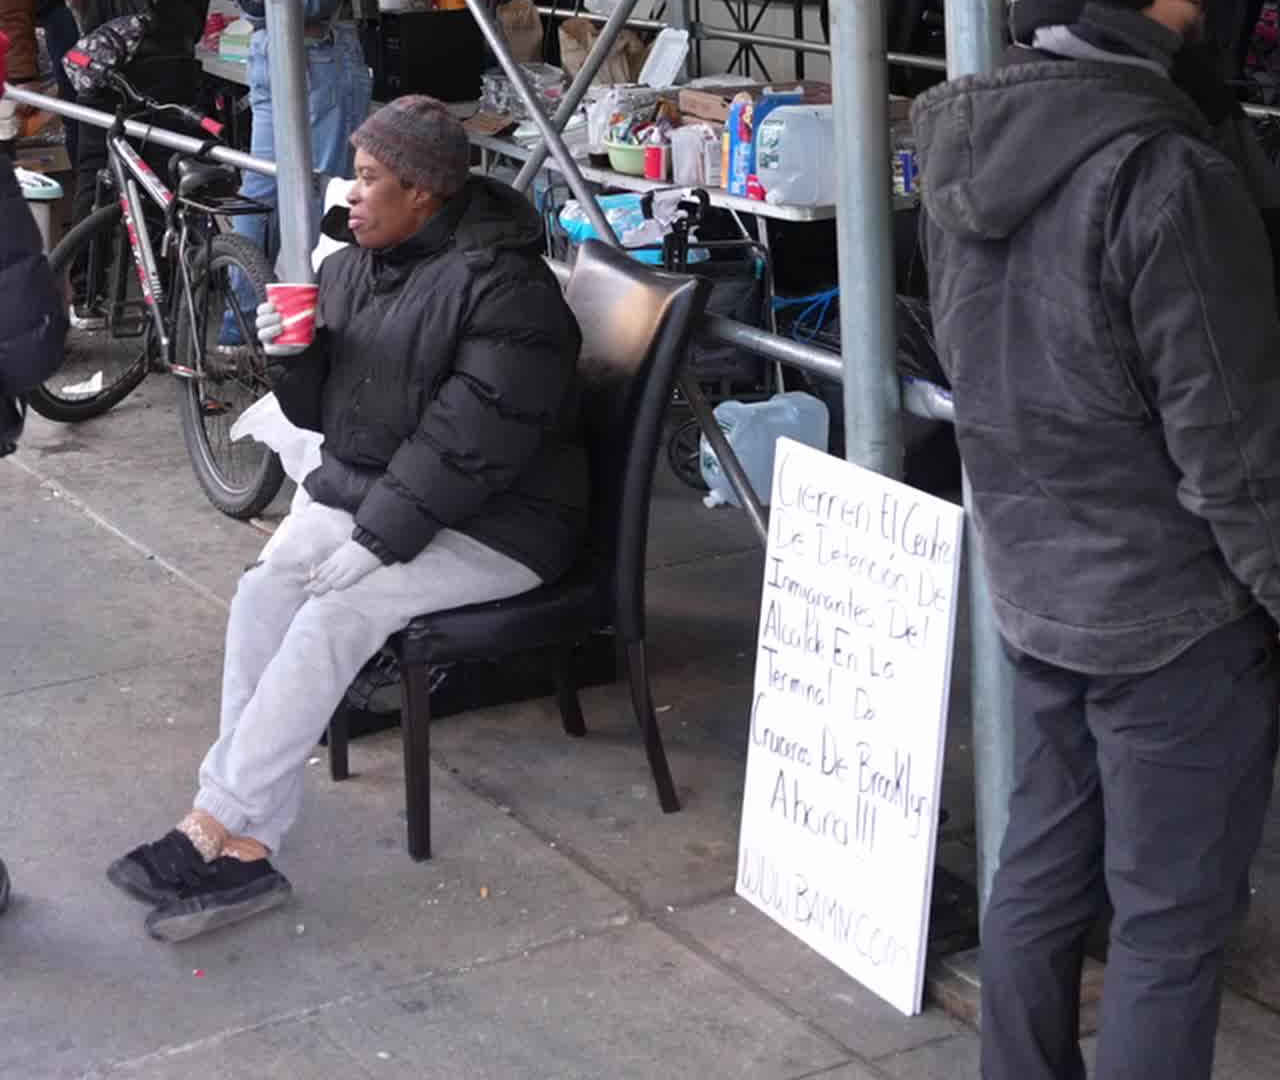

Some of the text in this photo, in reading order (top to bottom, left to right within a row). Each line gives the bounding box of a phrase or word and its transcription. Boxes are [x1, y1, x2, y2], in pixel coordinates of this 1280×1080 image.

[778, 451, 871, 533] Cierren
[880, 491, 899, 544] El
[917, 570, 946, 612] De
[887, 599, 931, 650] Del
[832, 627, 859, 672] En
[869, 646, 895, 680] La
[820, 724, 849, 783] De
